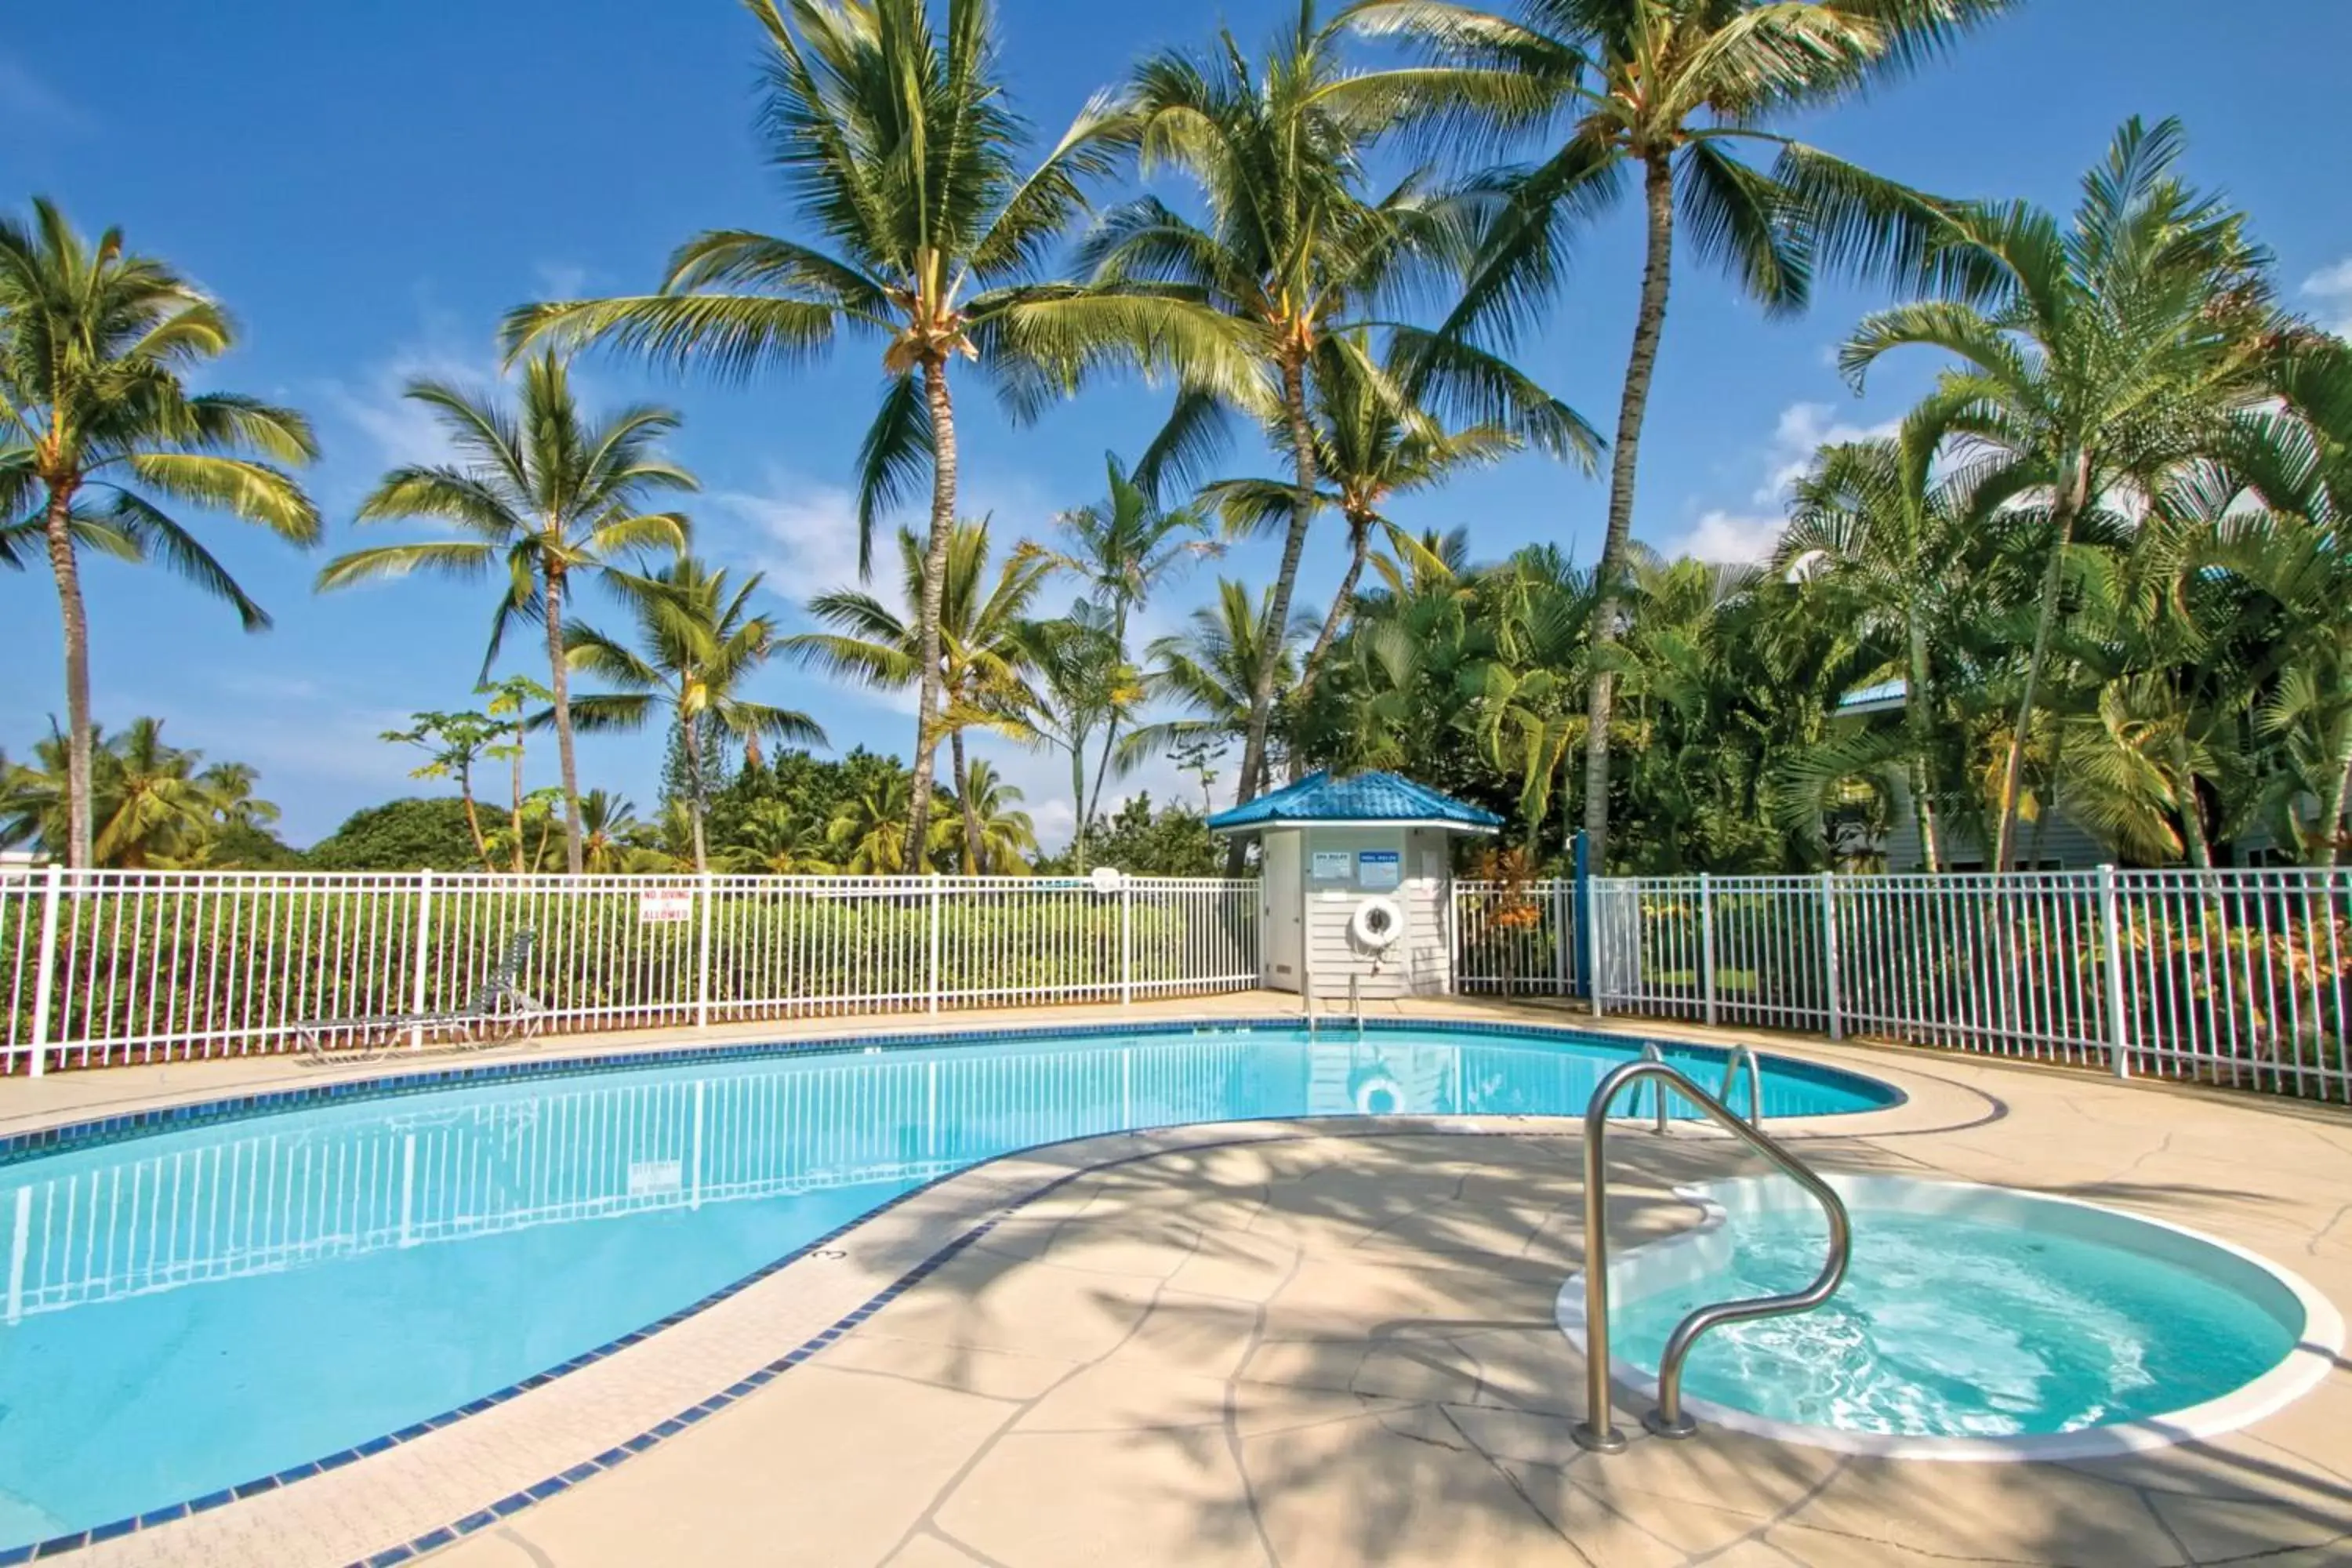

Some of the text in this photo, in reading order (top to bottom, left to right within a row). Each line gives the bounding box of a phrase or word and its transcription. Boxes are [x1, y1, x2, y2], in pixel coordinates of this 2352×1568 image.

[644, 890, 690, 899] NO DIVING
[643, 909, 688, 919] ALLOWED
